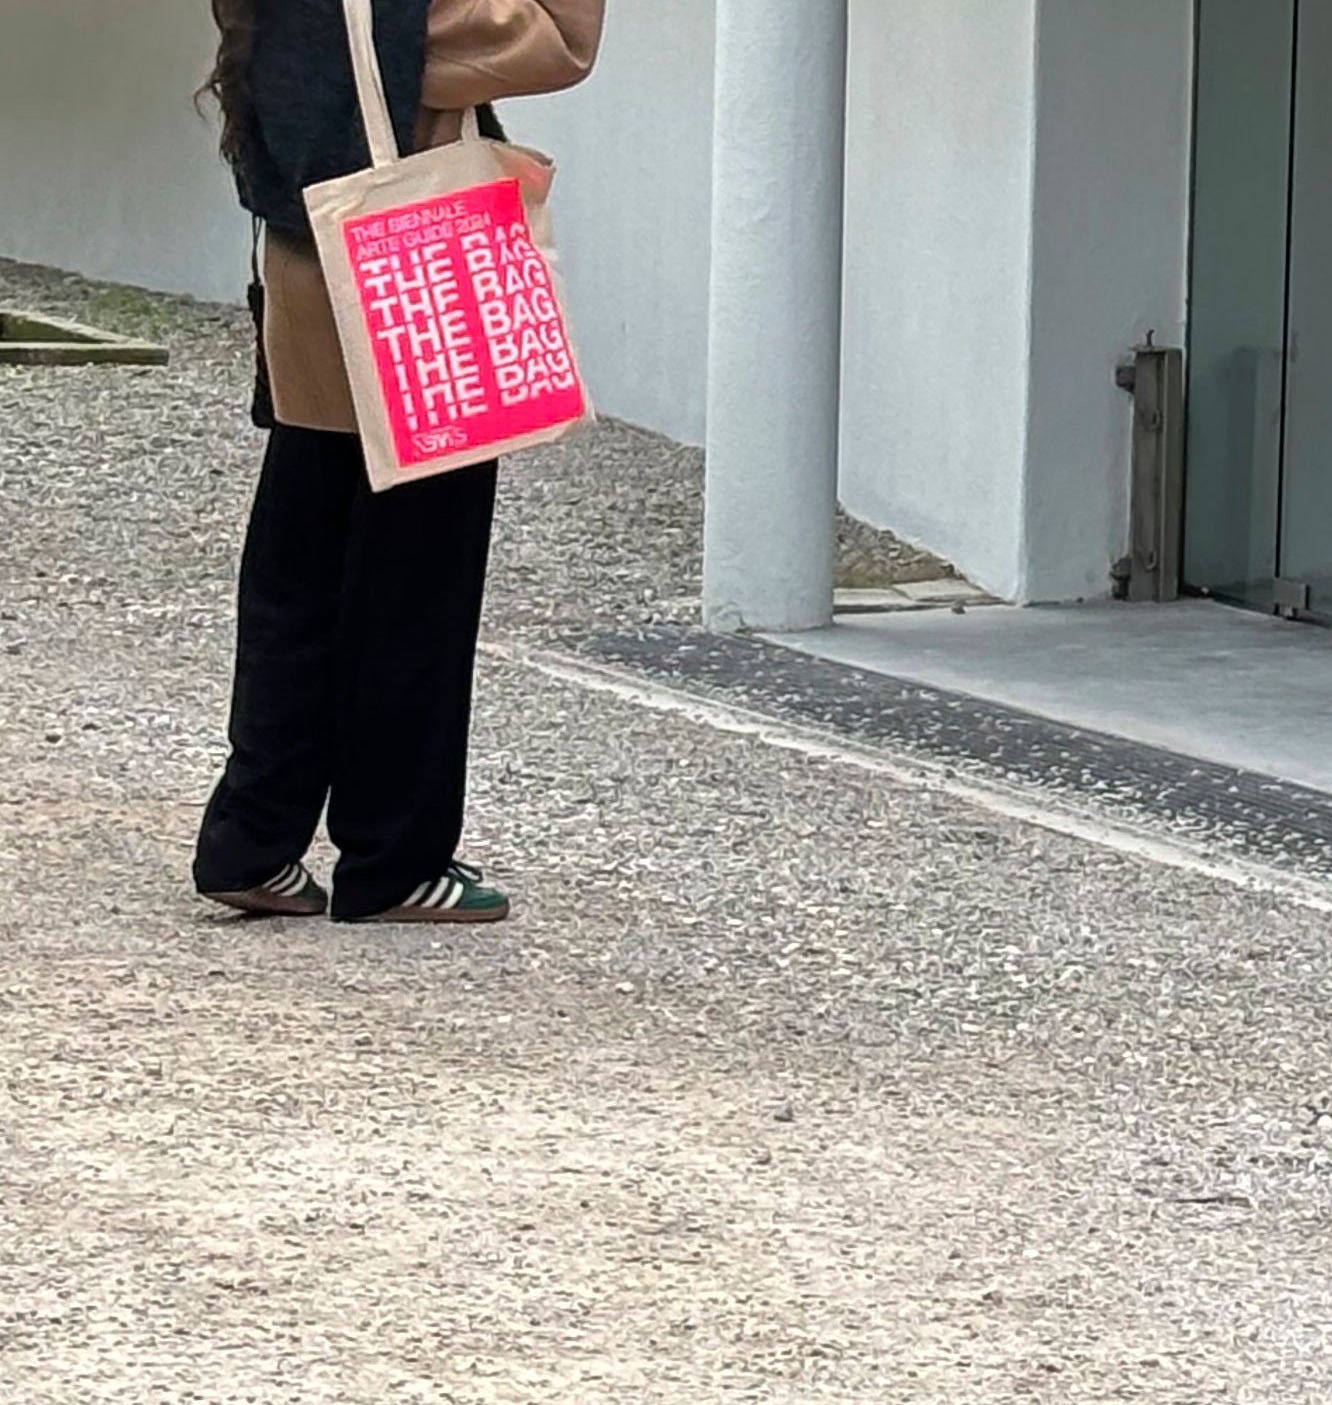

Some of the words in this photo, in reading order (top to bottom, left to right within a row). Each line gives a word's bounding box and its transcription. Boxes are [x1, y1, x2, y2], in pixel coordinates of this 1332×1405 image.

[350, 220, 386, 243] THE
[355, 236, 400, 261] ARTE
[402, 223, 453, 247] GUIDE
[377, 309, 471, 363] THE
[479, 287, 557, 337] BAG
